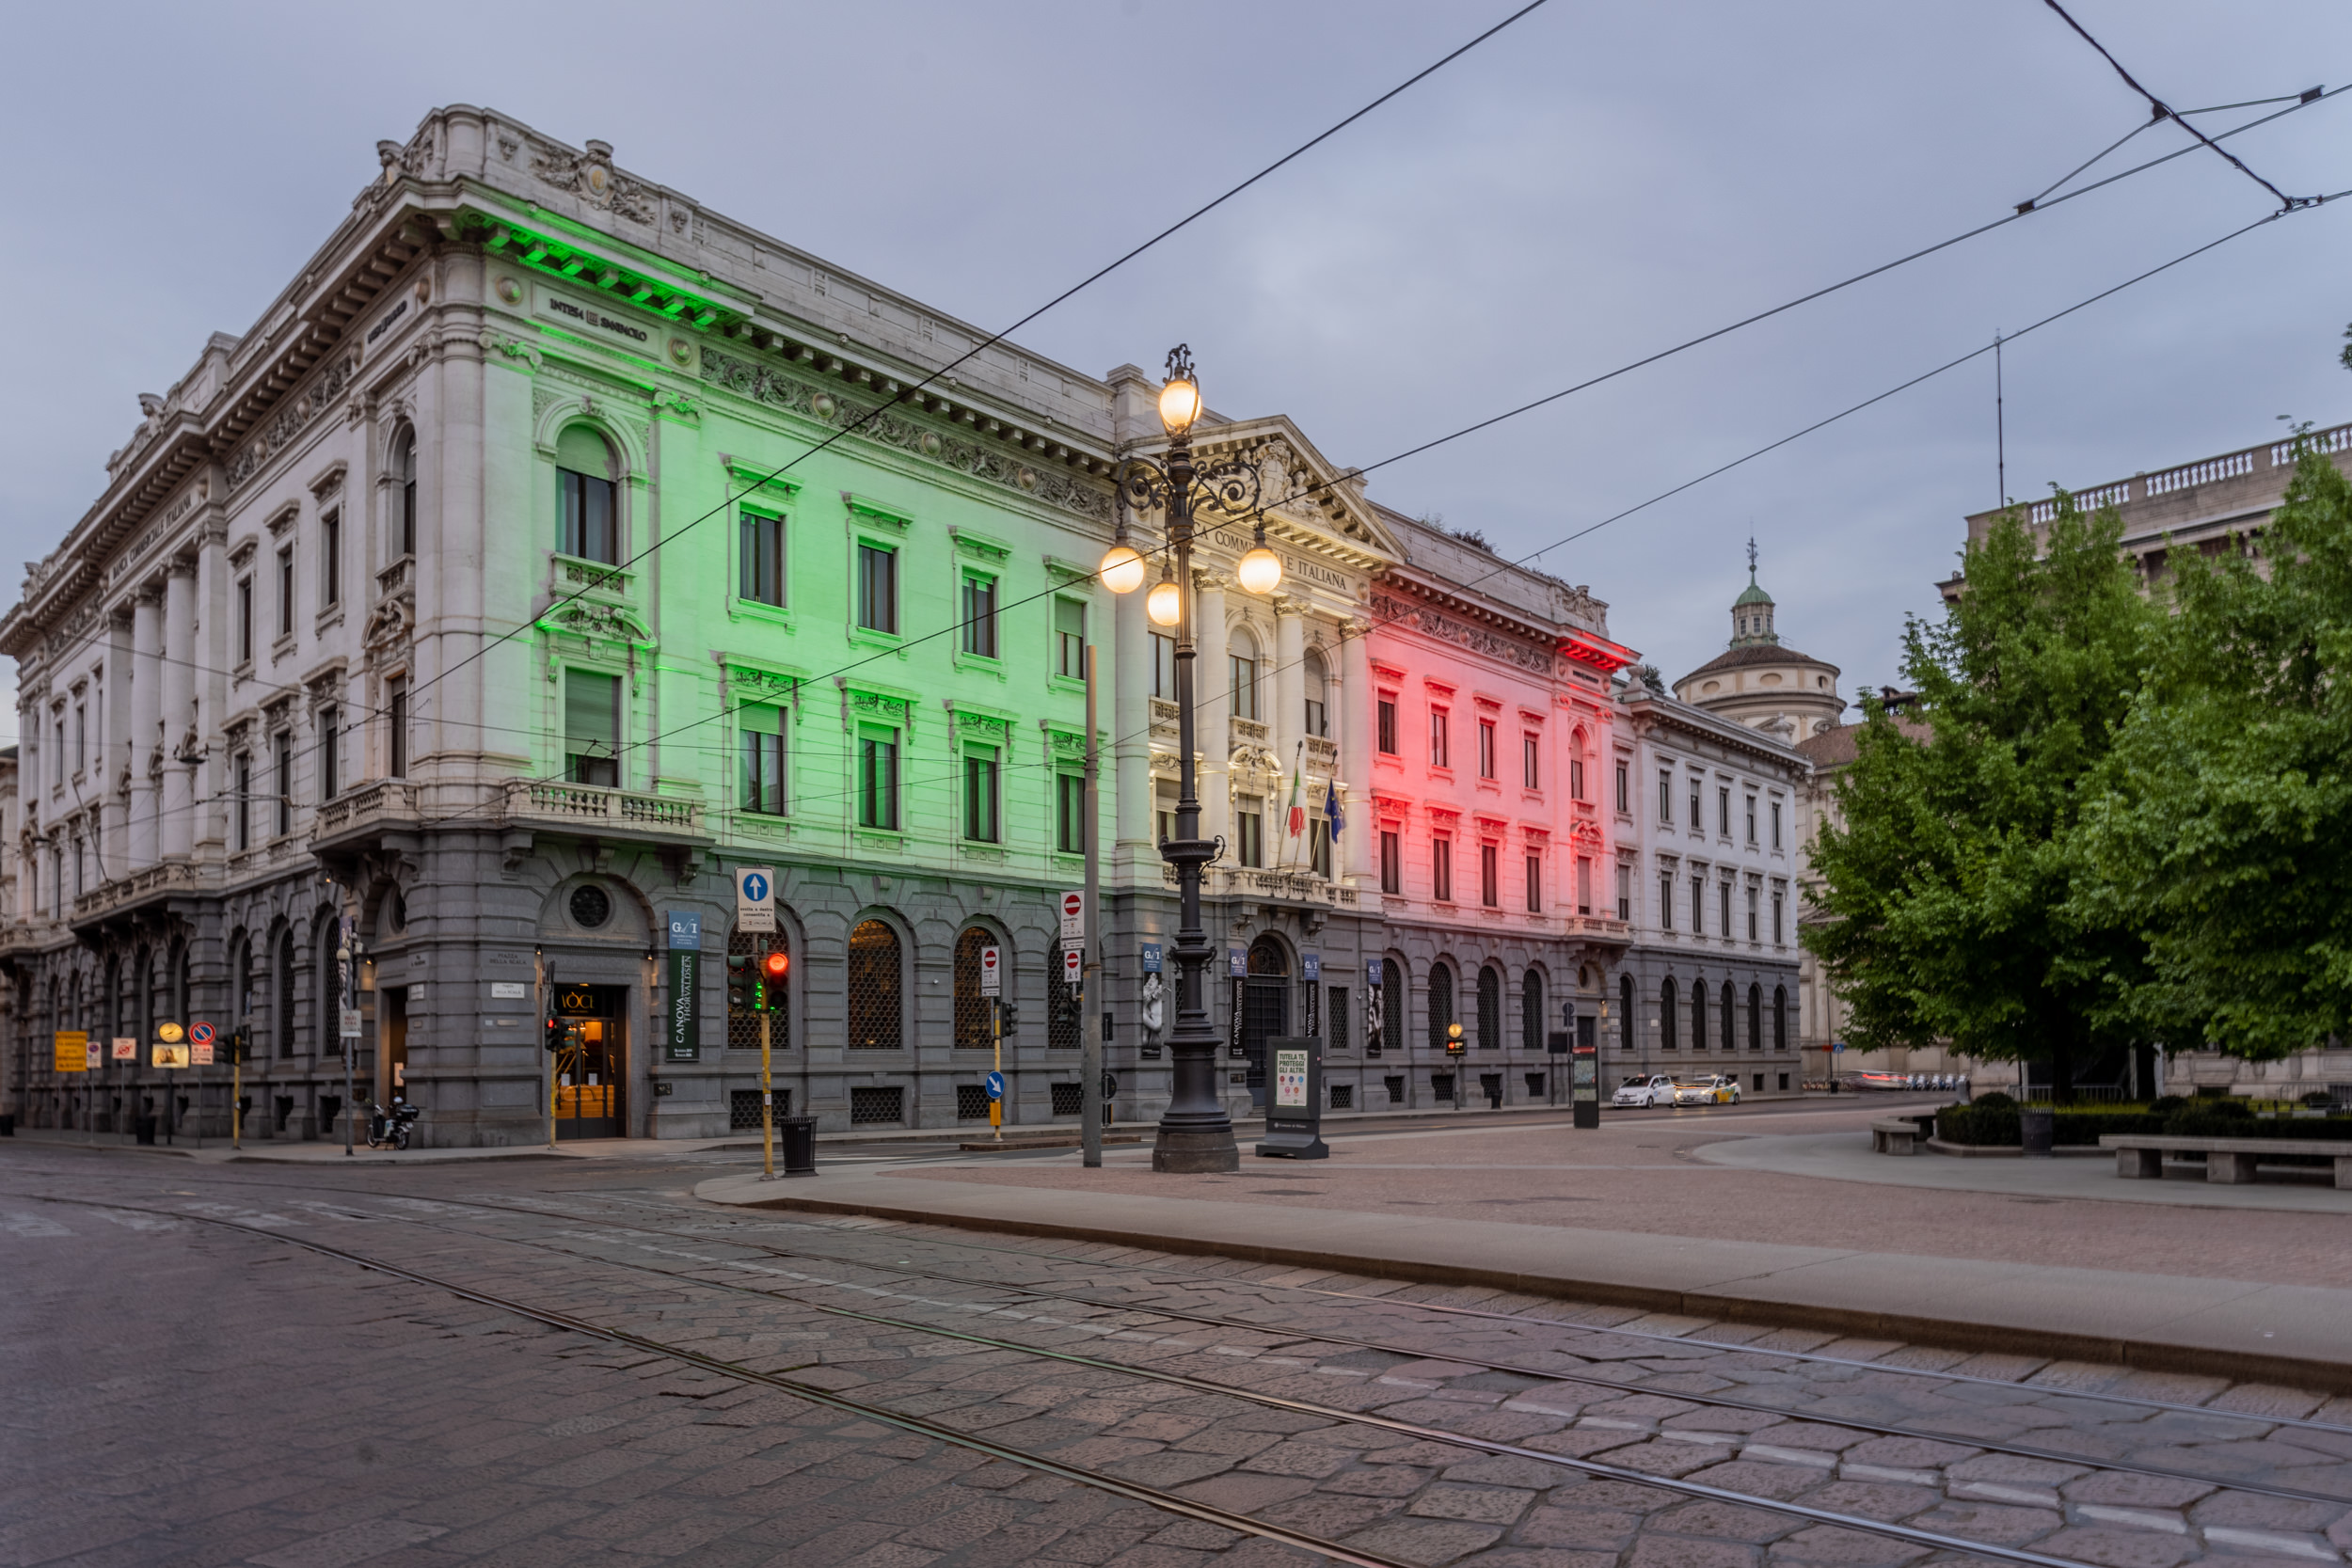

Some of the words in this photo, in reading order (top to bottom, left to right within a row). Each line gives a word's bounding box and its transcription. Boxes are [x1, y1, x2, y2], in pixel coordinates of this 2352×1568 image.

[549, 298, 584, 320] INTESA
[600, 317, 648, 341] SANPAOLO
[1298, 561, 1347, 591] ITALIANA
[675, 997, 685, 1043] CANOVA
